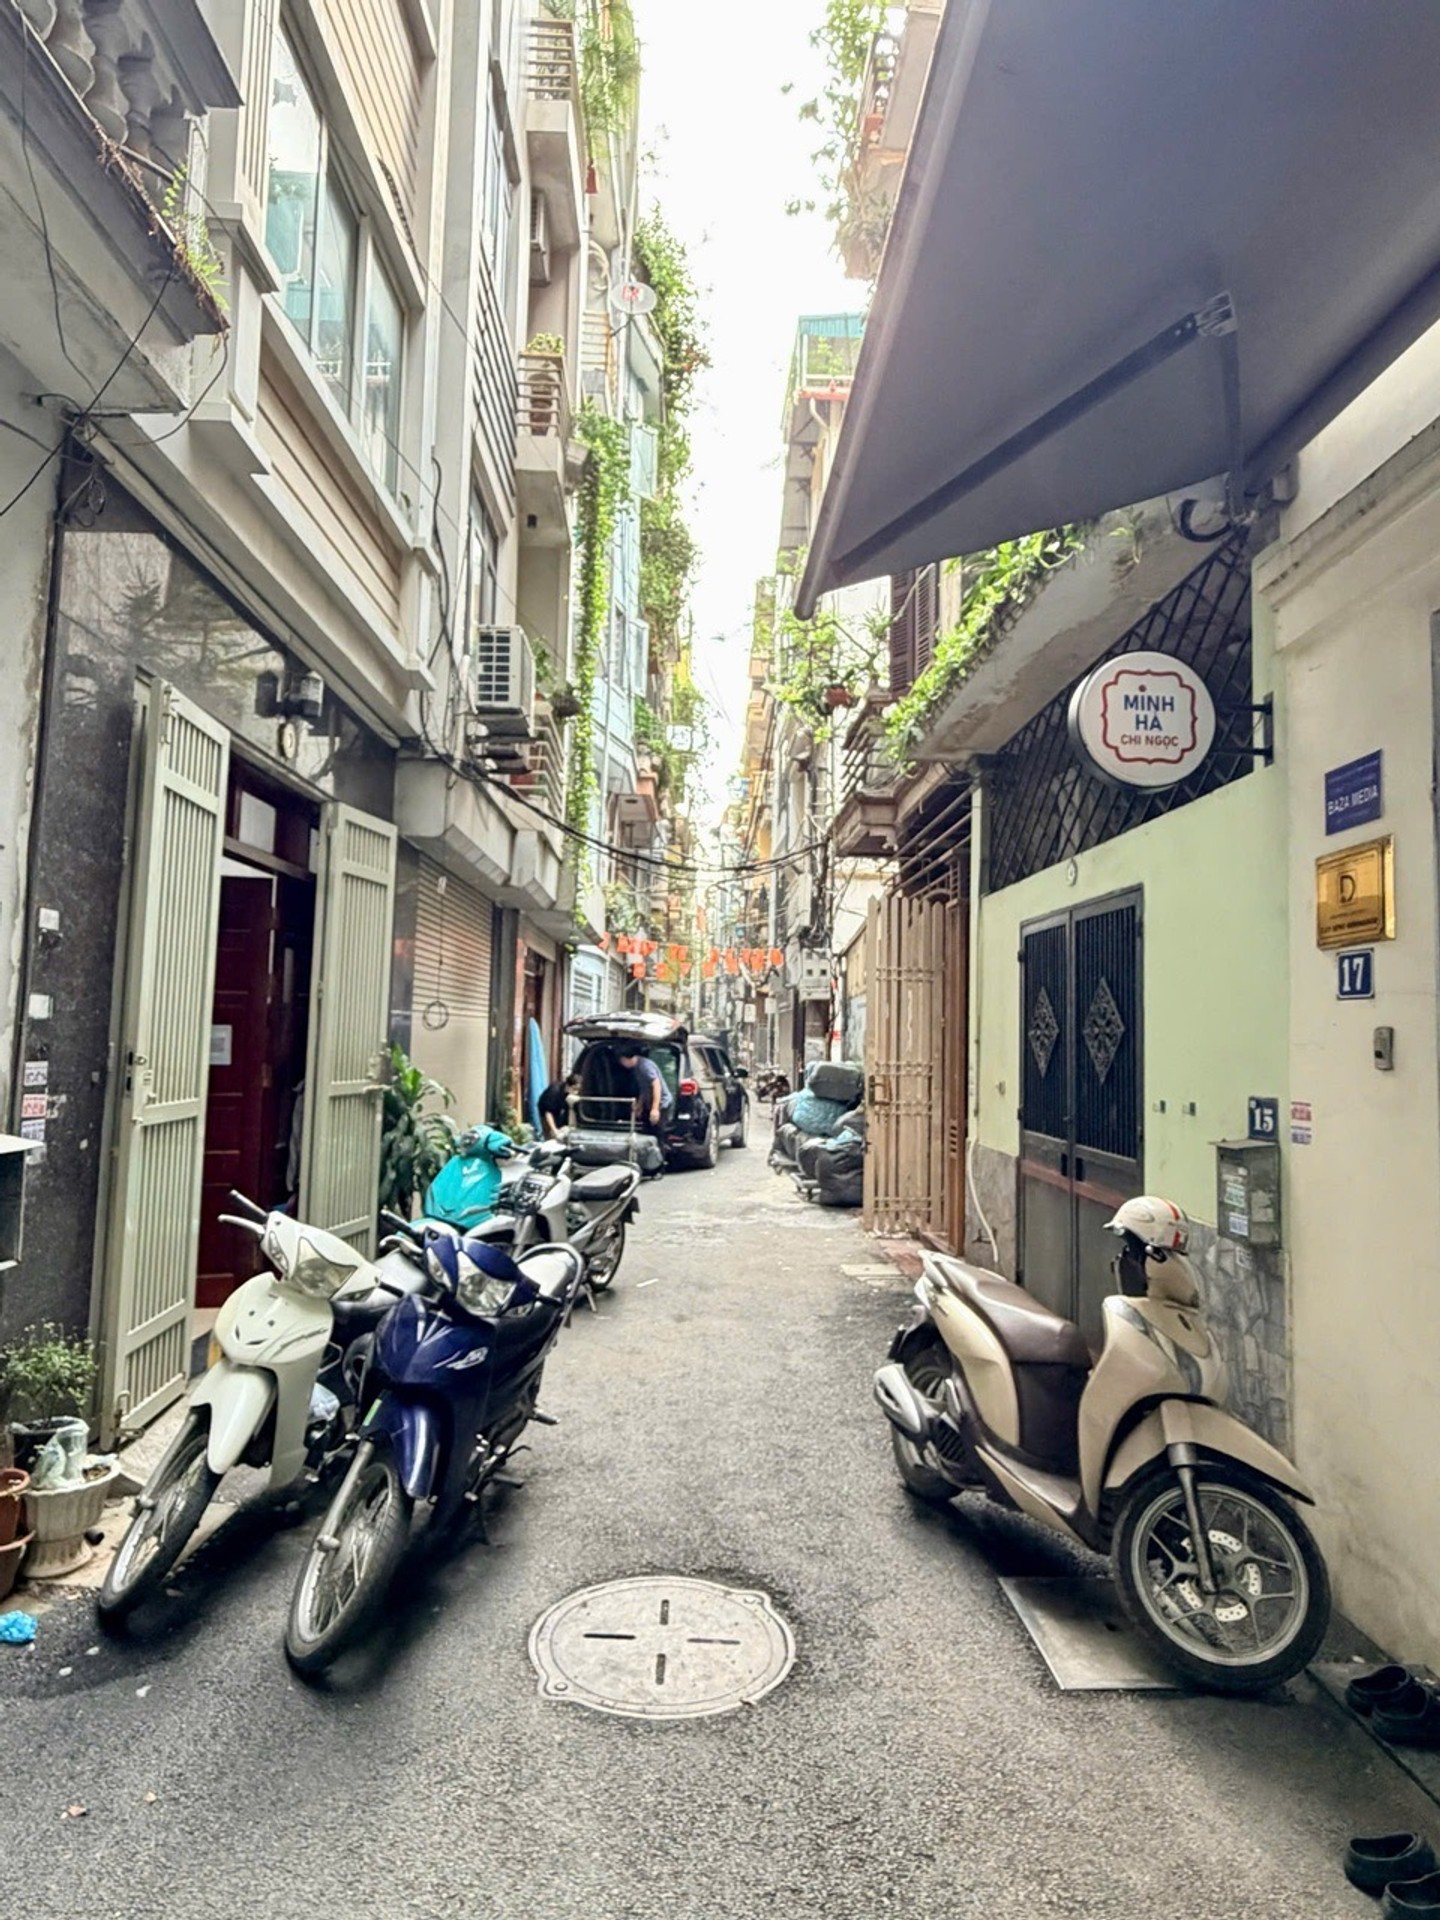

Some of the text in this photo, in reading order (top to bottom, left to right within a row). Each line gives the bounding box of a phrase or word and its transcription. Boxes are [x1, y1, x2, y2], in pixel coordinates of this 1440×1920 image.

[1123, 694, 1174, 712] MINH
[1120, 733, 1179, 750] CHI NGỌC
[1339, 874, 1356, 904] D
[1342, 956, 1364, 992] 17
[1254, 1108, 1274, 1132] 15
